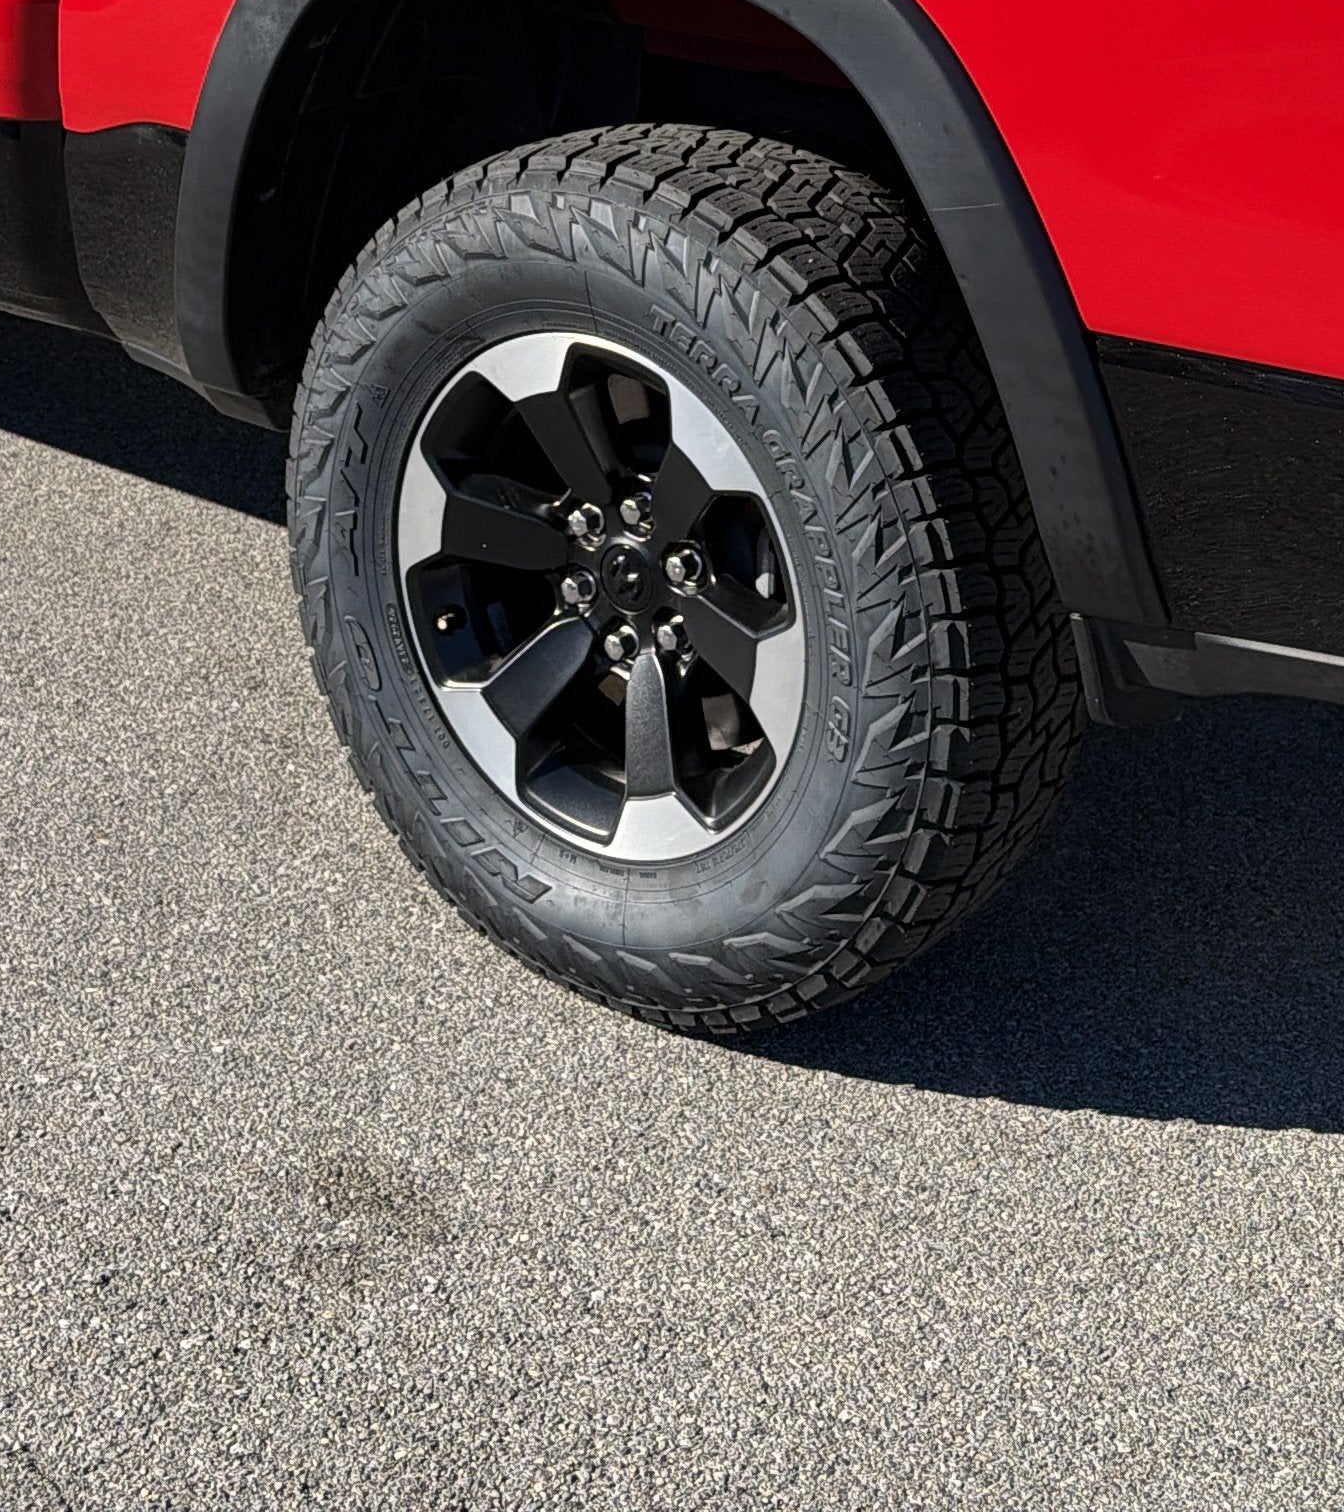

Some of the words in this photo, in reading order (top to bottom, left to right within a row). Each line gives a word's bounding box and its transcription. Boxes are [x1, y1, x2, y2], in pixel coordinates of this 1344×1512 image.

[650, 303, 762, 428] TERRA
[761, 429, 854, 686] GRAPPLER
[825, 694, 851, 764] G3
[344, 614, 554, 905] NITTO
